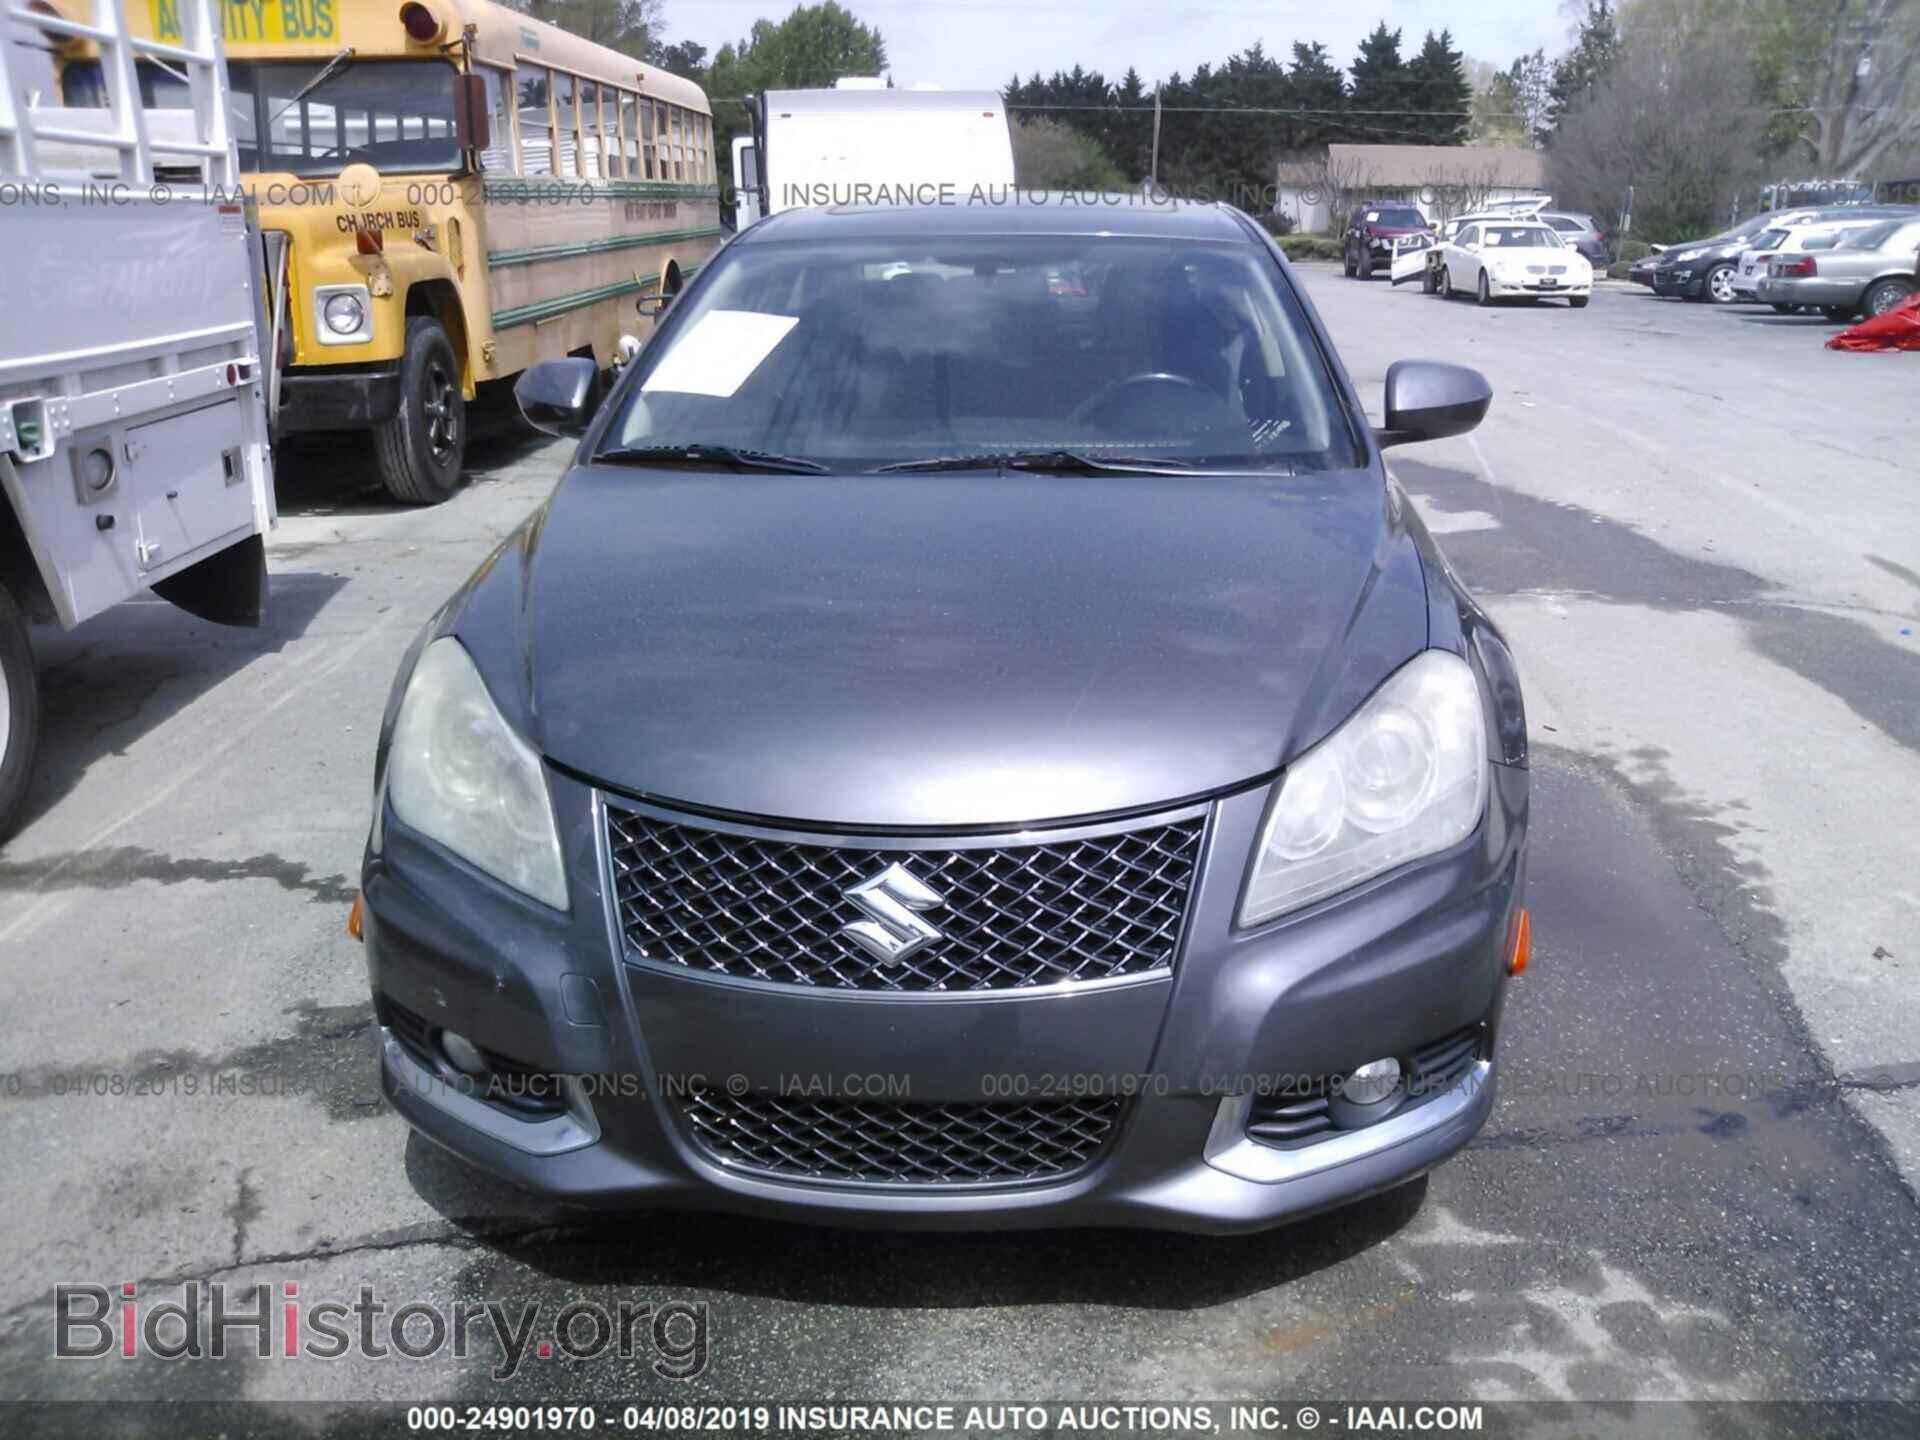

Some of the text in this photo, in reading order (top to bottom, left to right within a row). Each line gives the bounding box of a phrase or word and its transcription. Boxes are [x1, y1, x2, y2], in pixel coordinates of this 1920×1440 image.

[157, 0, 335, 38] AVITY BUS
[396, 210, 420, 229] BUS
